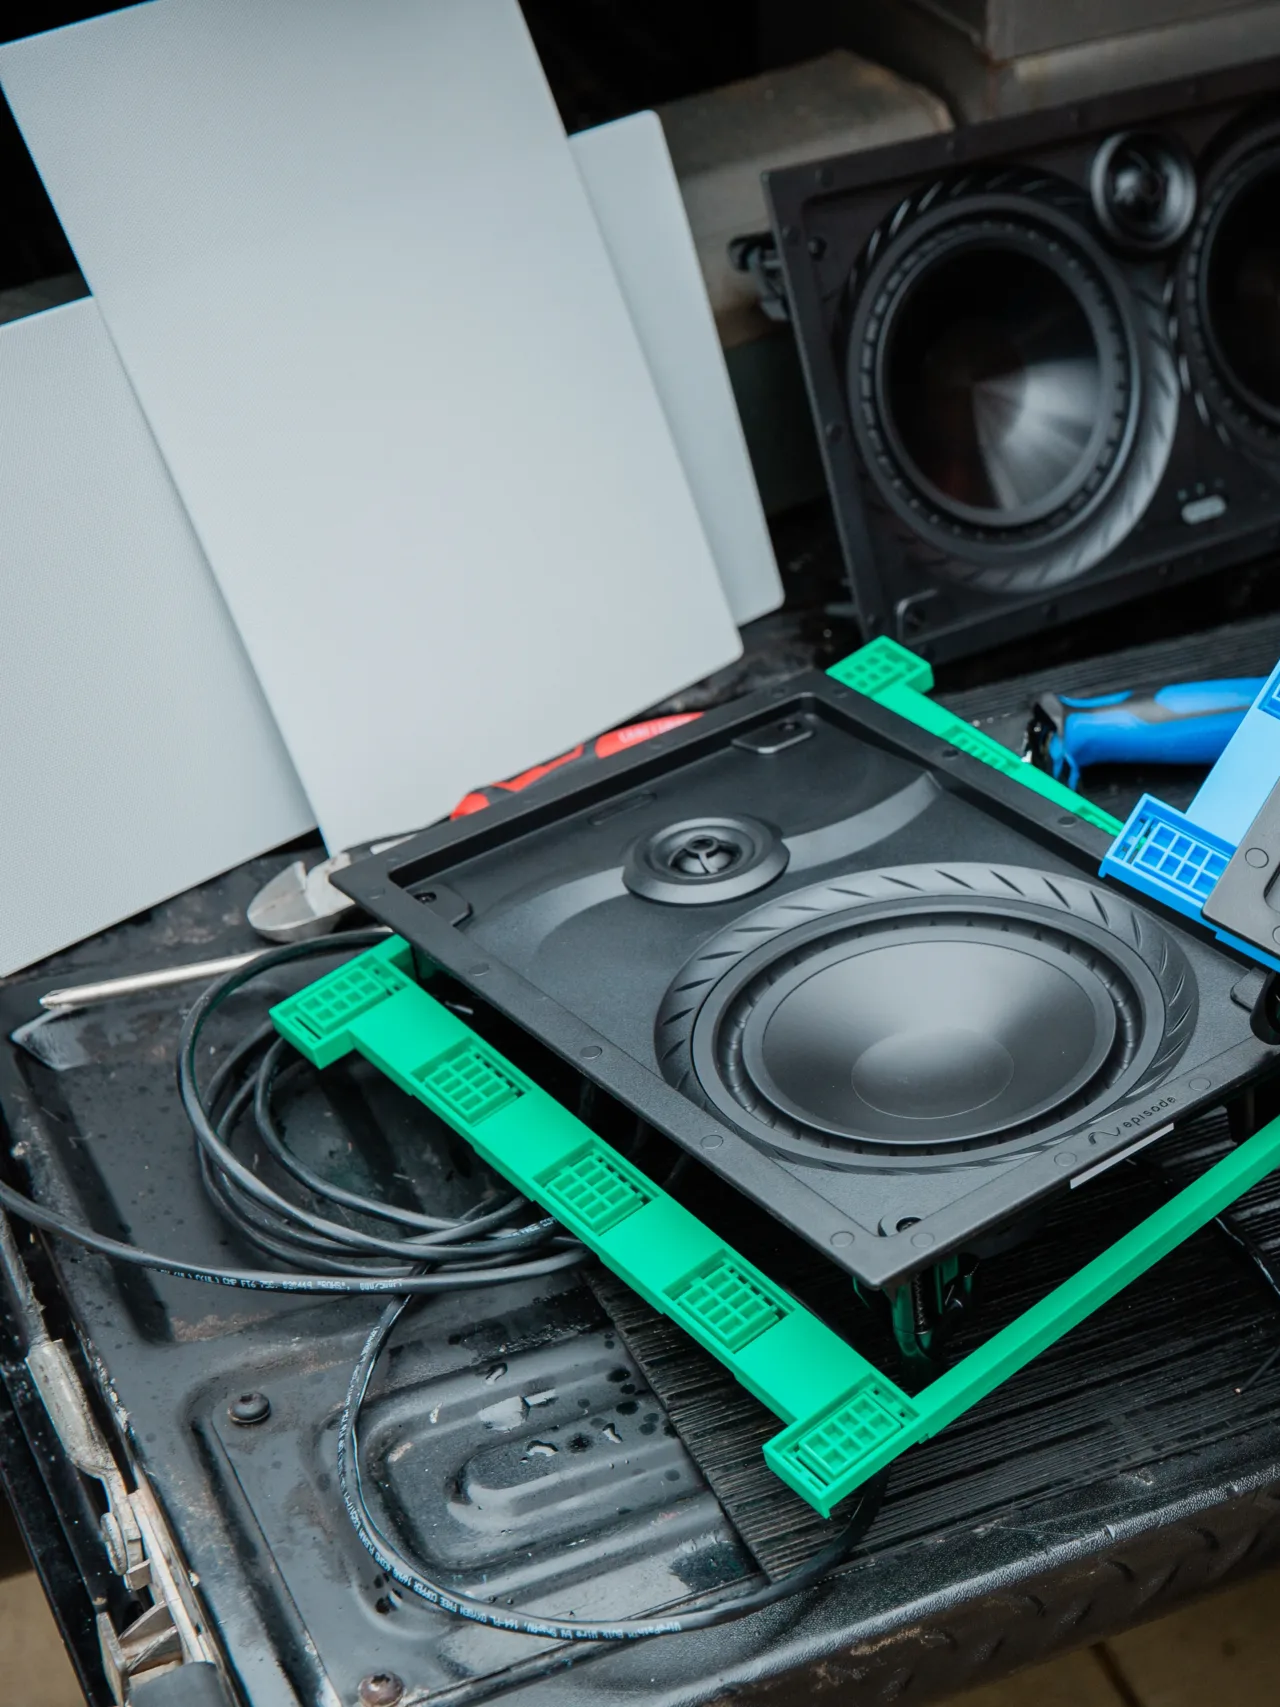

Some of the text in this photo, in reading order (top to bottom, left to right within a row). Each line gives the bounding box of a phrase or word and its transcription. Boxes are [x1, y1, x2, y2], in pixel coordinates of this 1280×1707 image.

[1123, 1096, 1176, 1128] episode
[240, 1279, 257, 1289] FT6
[412, 1580, 438, 1603] COPPER
[439, 1596, 458, 1613] FREE
[459, 1604, 488, 1623] OXYGEN
[559, 1628, 573, 1640] by
[574, 1629, 599, 1640] Wire
[601, 1629, 624, 1640] Bulk
